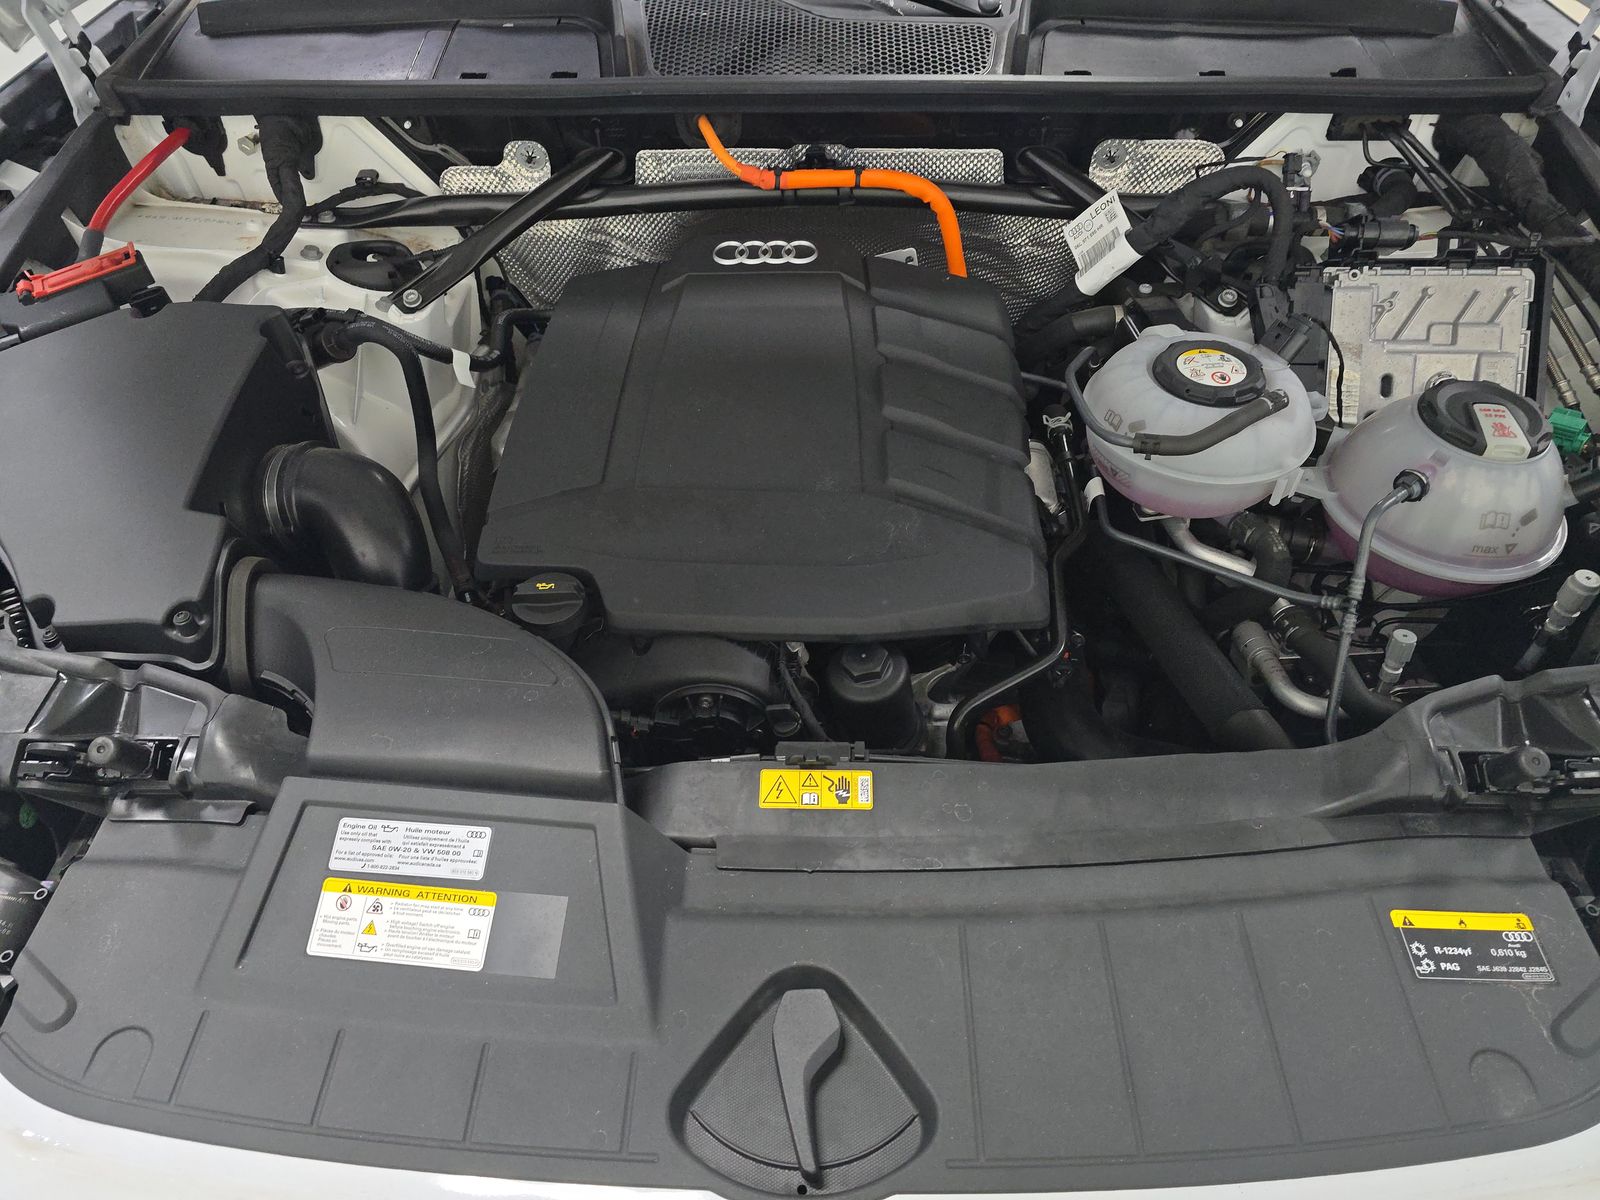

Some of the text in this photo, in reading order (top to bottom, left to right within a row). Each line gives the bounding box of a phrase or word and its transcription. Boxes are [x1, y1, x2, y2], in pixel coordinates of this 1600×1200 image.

[1090, 196, 1115, 219] LEONI
[1472, 544, 1498, 554] max
[357, 885, 478, 903] WARNING ATTENTION
[1434, 946, 1472, 956] R-1234yf
[1490, 948, 1528, 958] 0,610 kg
[1440, 962, 1461, 971] PAG
